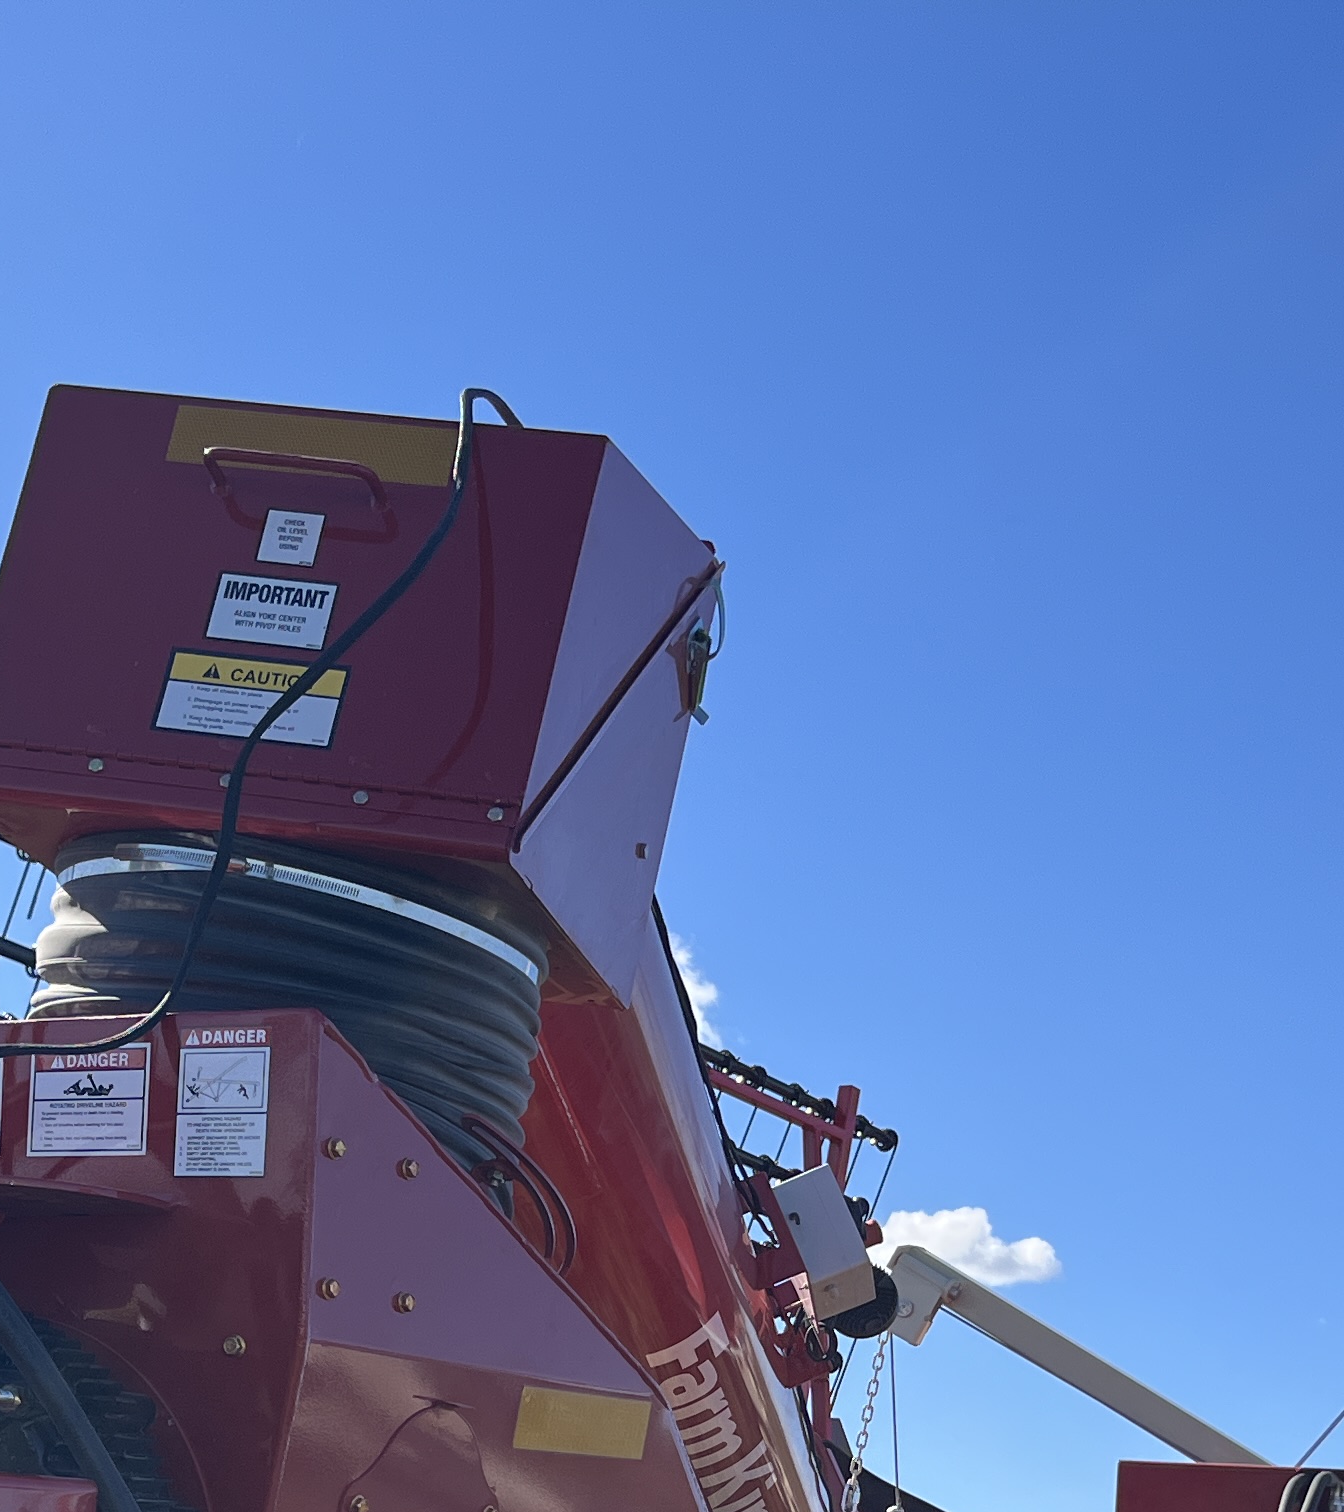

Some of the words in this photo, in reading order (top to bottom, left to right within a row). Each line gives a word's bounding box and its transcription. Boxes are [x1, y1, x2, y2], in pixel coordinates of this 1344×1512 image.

[224, 581, 328, 608] IMPORTANT
[279, 615, 306, 623] CENTER
[255, 622, 276, 630] PIVOT
[278, 624, 301, 633] HOLES
[231, 669, 299, 688] CAUTIO
[202, 1030, 266, 1044] DANGER
[67, 1053, 128, 1067] DANGER
